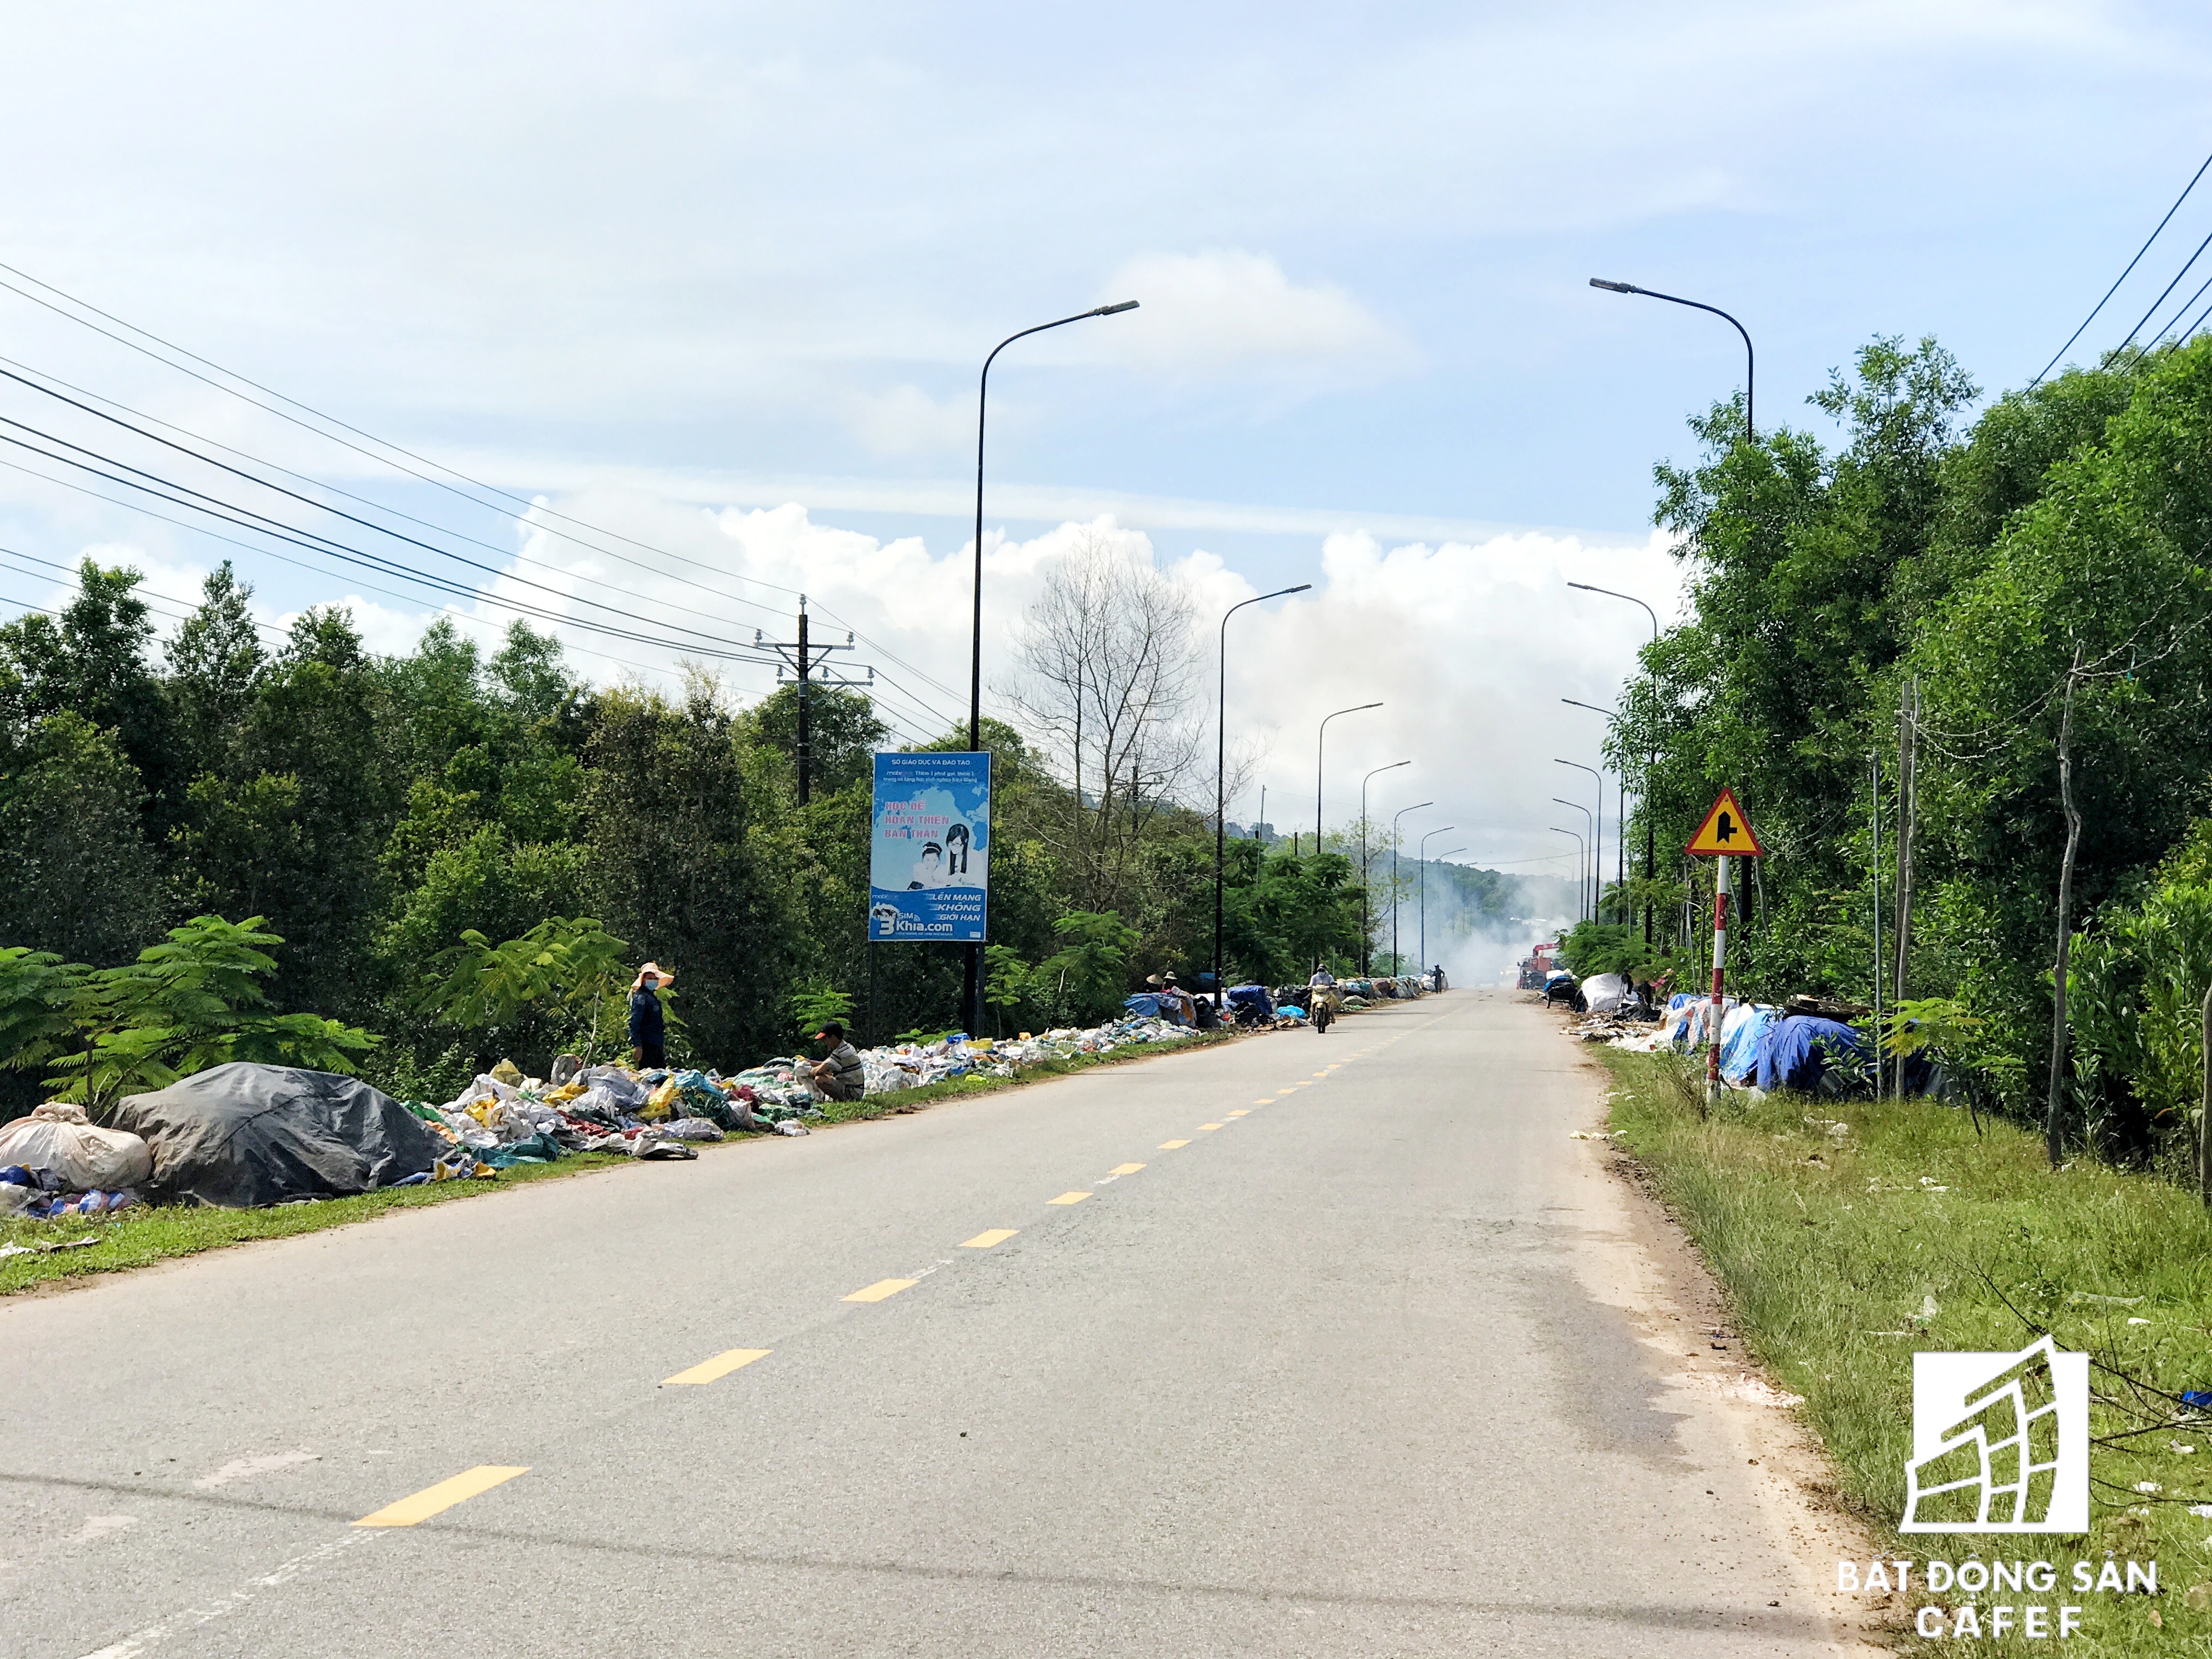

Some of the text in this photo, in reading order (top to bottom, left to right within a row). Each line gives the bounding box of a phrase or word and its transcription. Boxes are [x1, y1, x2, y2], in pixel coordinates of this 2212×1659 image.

[952, 894, 981, 902] MẠNG
[938, 902, 981, 911] KHÔNG
[960, 914, 981, 922] HẠN
